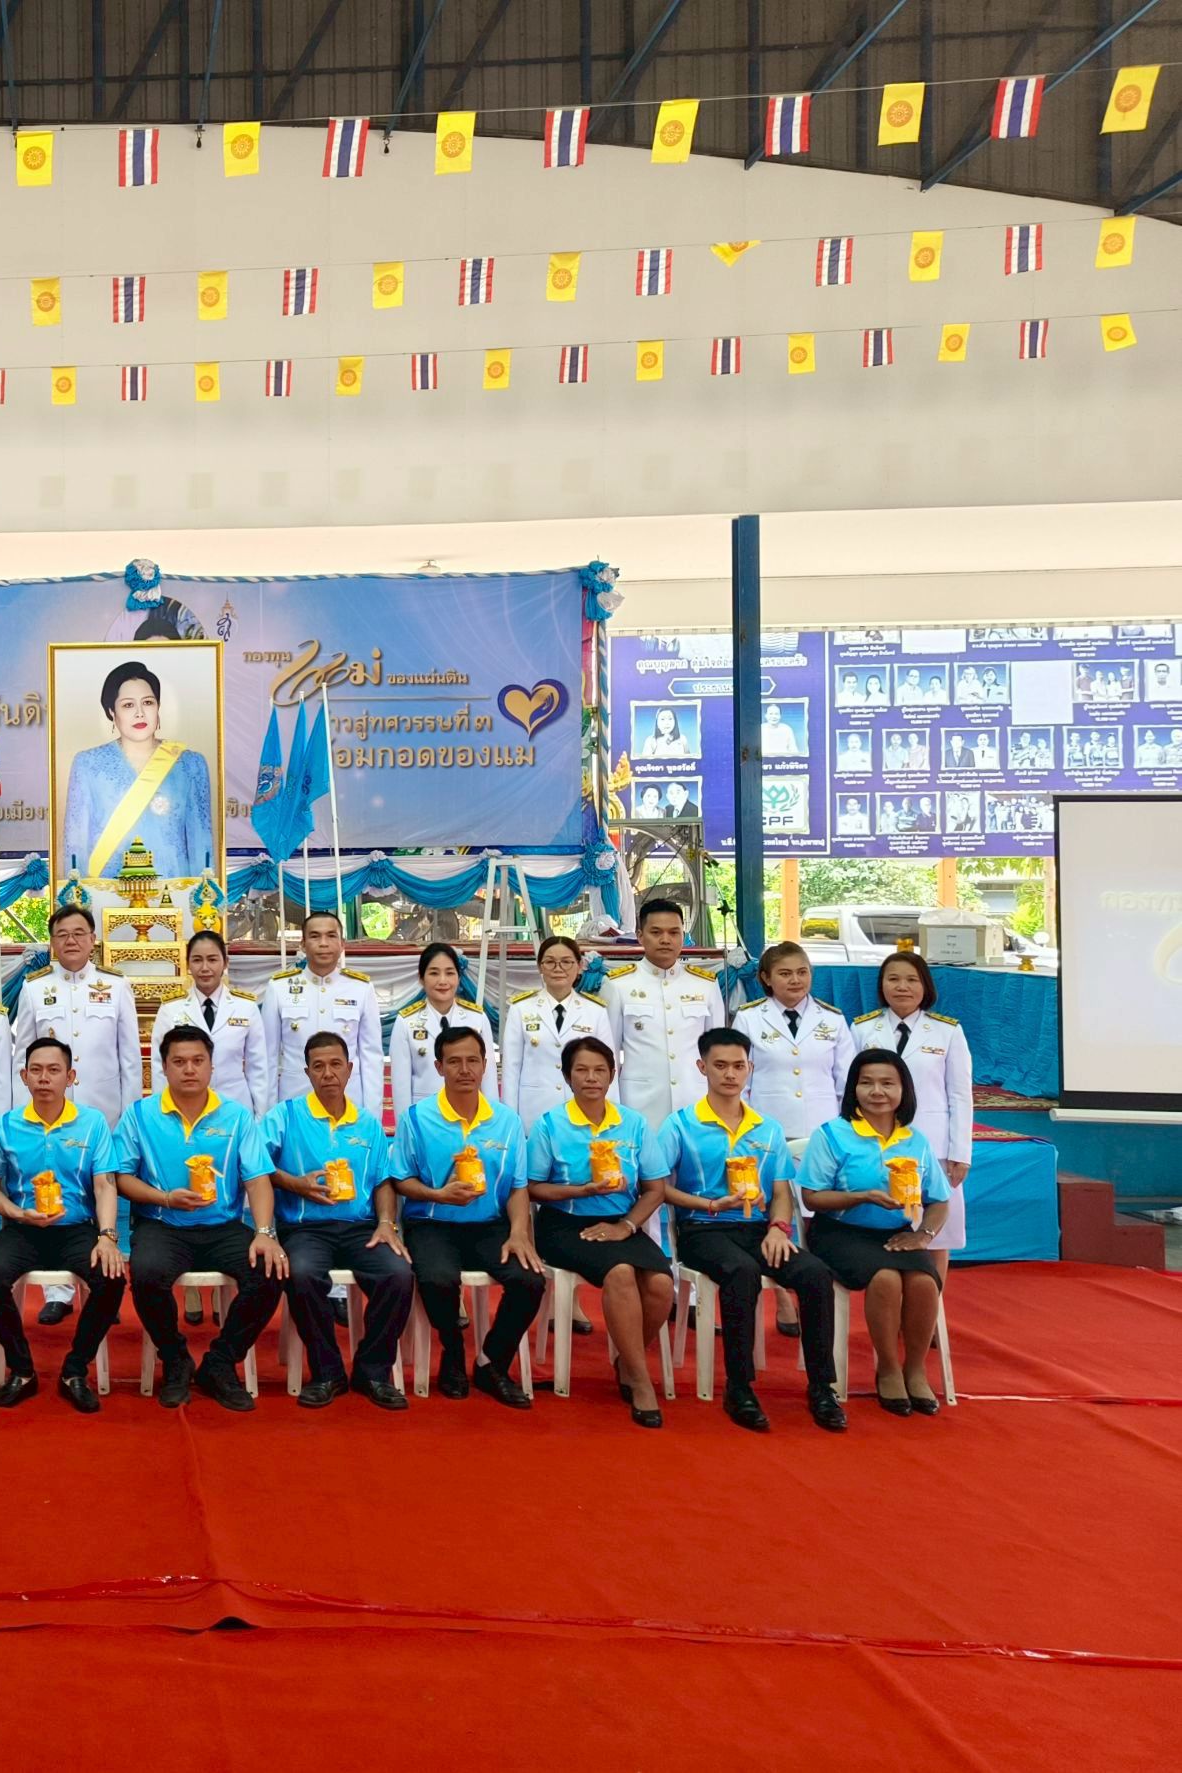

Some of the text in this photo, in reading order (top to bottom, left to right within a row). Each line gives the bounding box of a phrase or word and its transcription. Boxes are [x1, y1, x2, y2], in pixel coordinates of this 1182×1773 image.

[386, 667, 470, 686] ของแผ่นดิน
[473, 715, 492, 731] ๓
